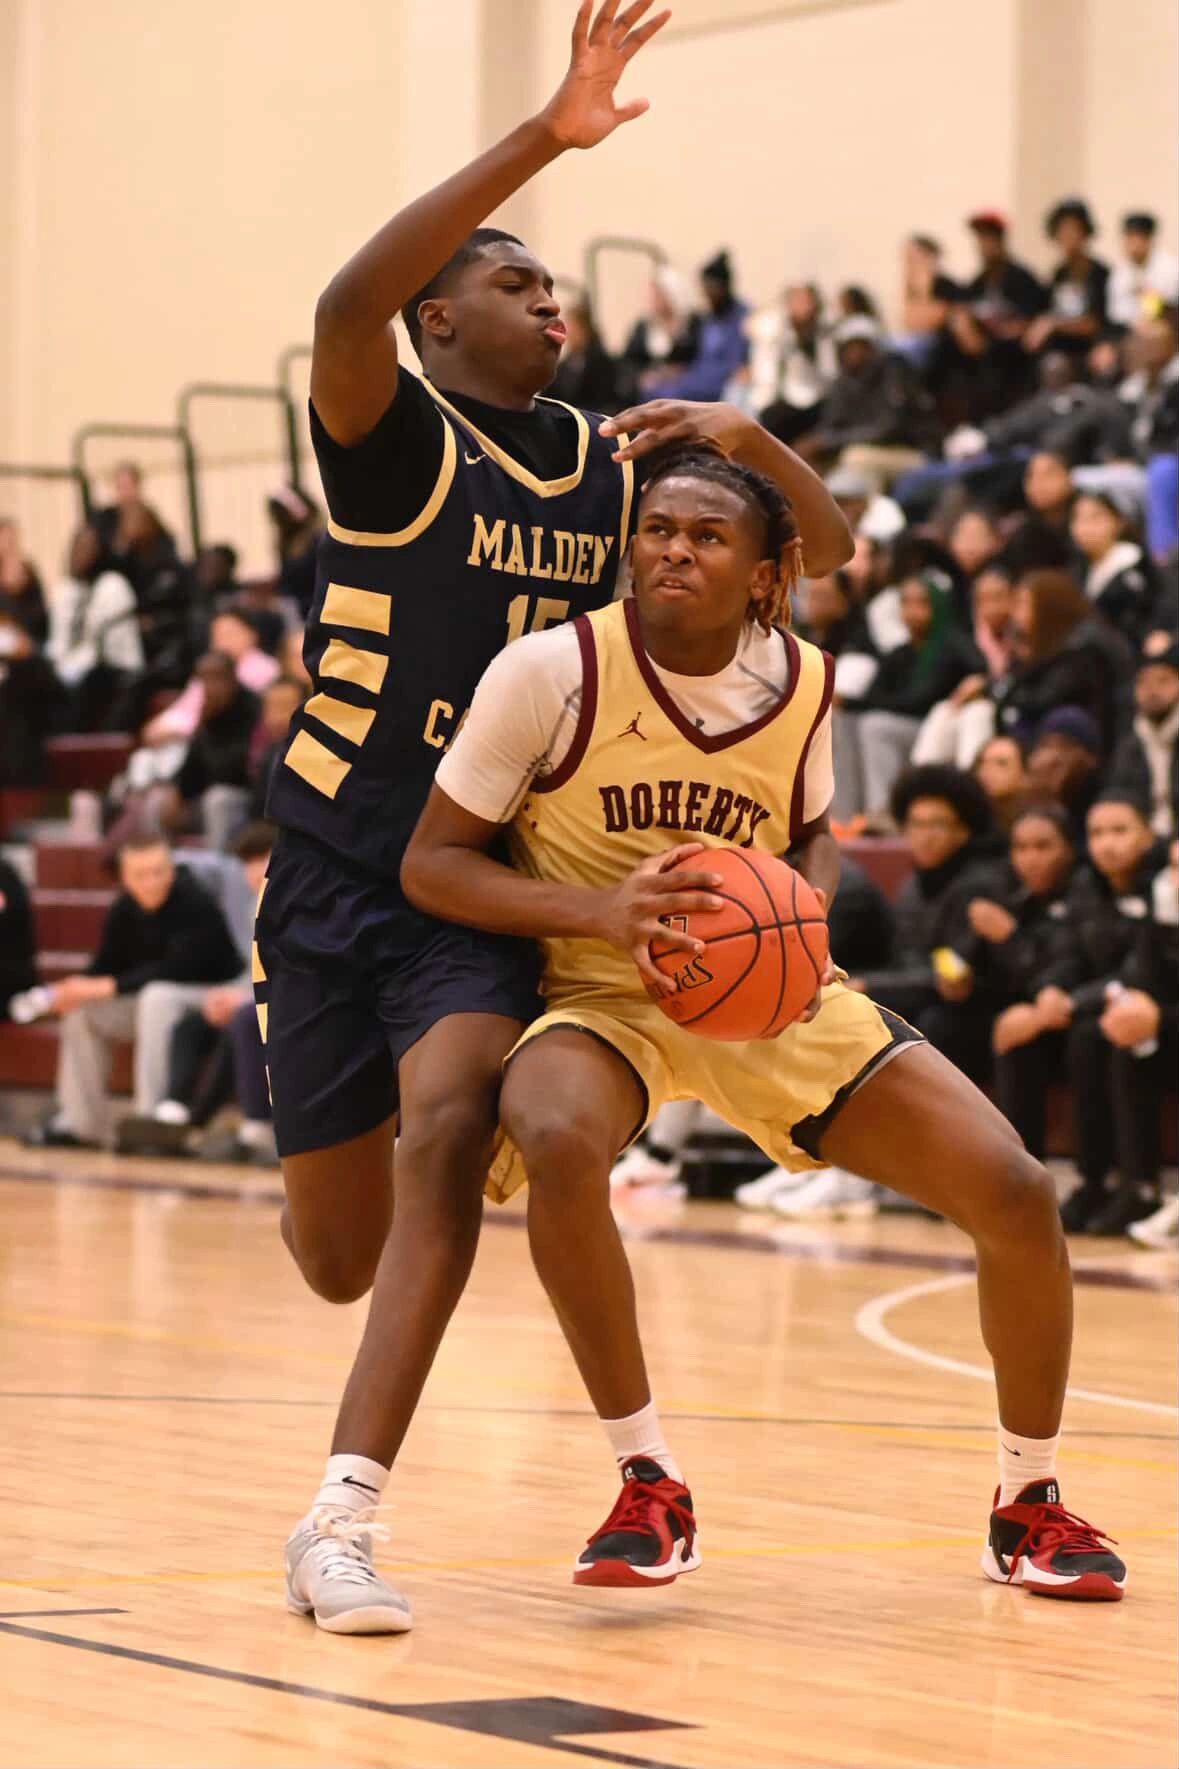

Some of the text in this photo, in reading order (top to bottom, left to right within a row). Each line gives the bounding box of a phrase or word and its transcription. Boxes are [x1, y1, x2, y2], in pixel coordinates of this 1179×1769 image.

[467, 513, 615, 584] MALDEN
[423, 699, 470, 752] C
[599, 780, 771, 848] DOHERTY
